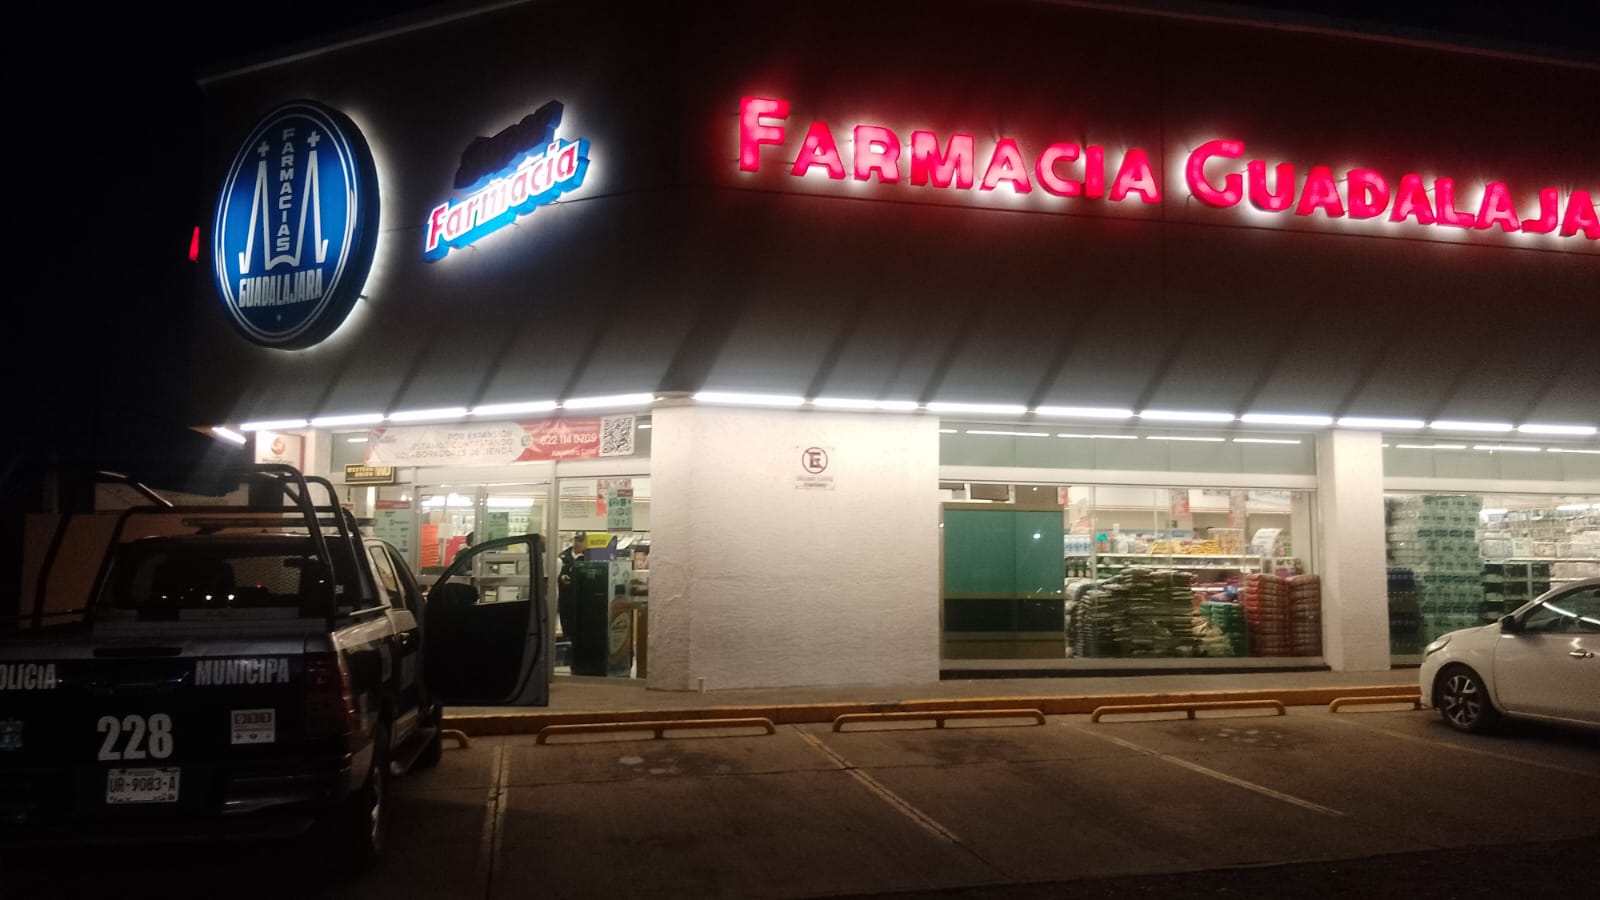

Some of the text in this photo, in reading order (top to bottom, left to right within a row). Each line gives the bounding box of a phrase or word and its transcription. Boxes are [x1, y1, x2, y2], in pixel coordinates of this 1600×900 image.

[276, 128, 295, 252] FARMACIAS
[425, 141, 579, 252] Farmacia
[739, 97, 1600, 241] FARMACIA GUADALAJA
[238, 267, 323, 308] GUADALAJARA
[194, 657, 291, 687] MUNICIPA
[97, 713, 174, 761] 228
